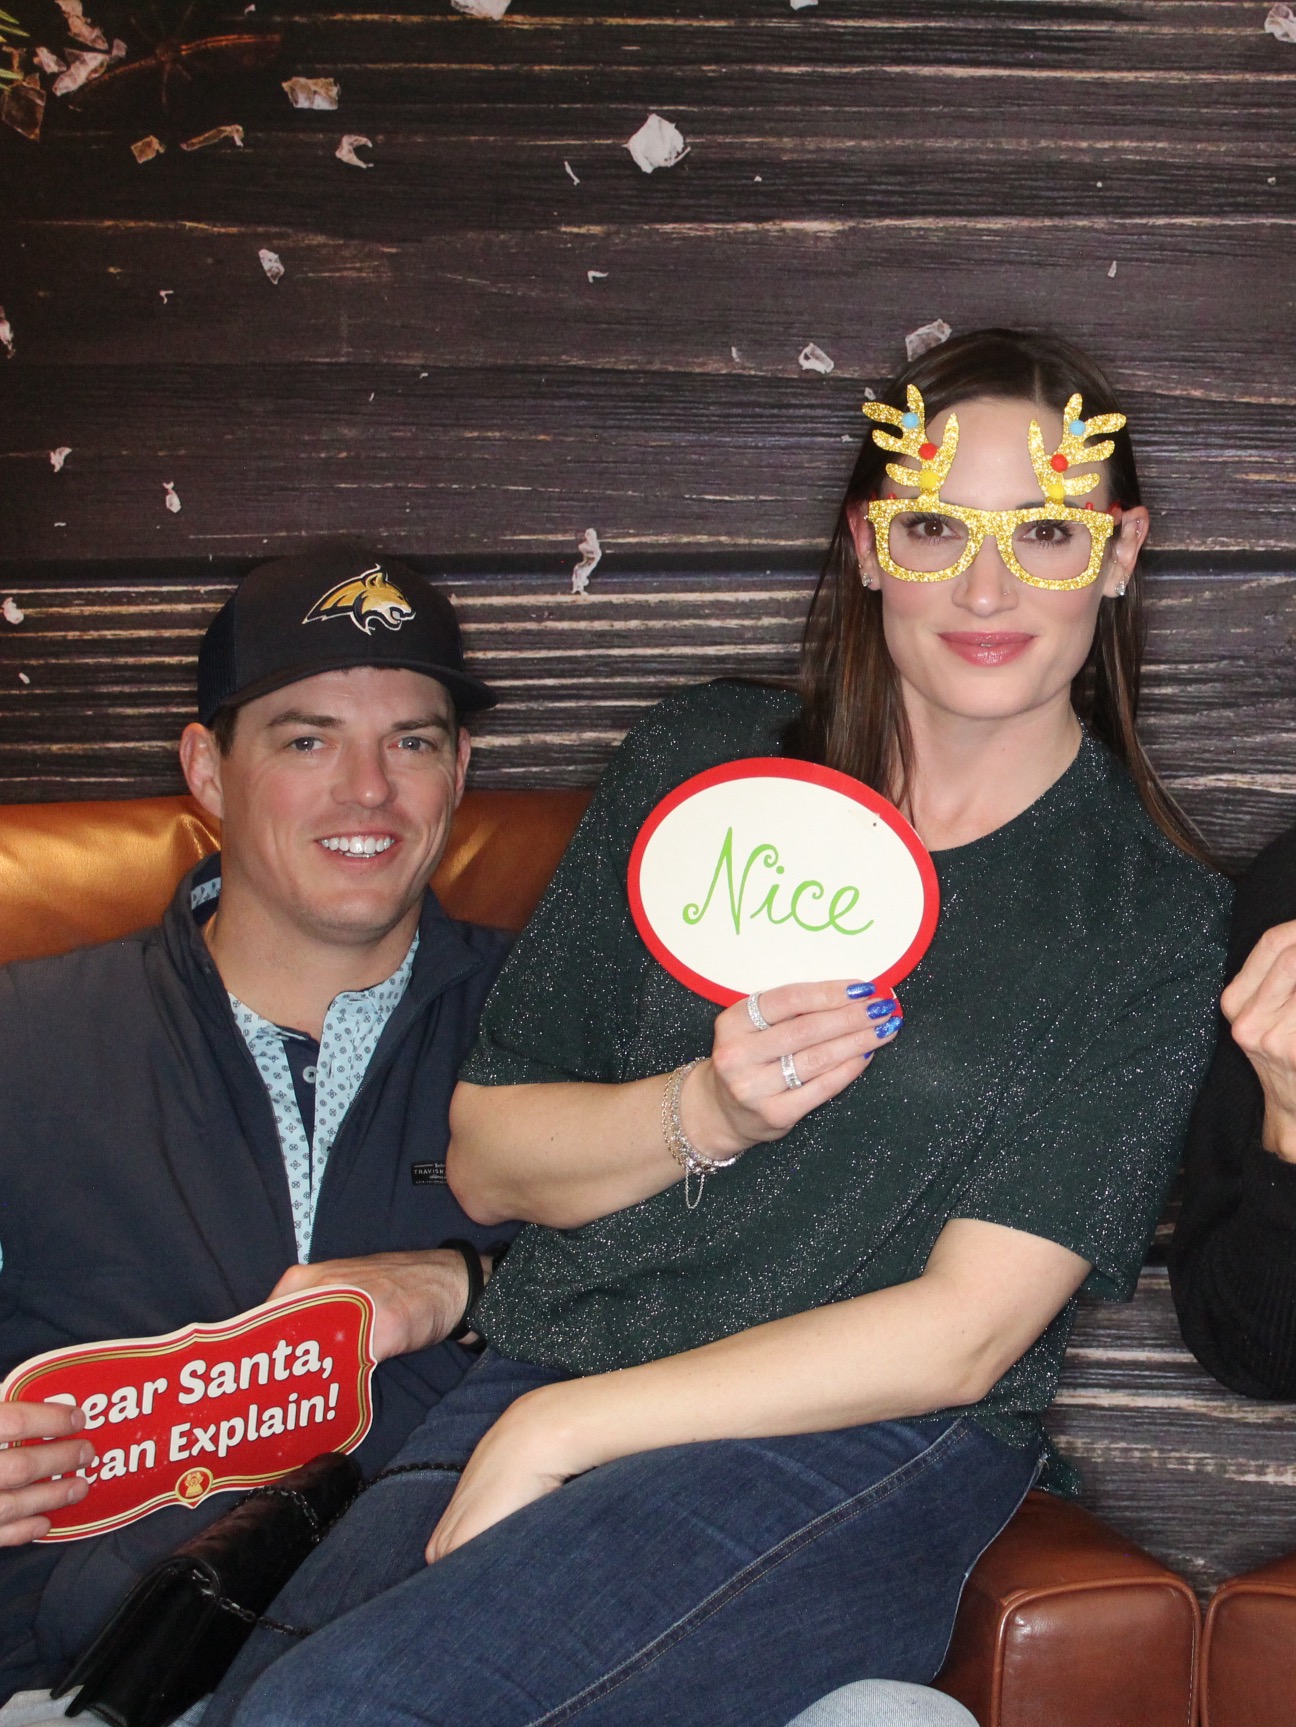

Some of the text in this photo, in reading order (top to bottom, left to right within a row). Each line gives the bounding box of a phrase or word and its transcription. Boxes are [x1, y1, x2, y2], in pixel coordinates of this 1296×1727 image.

[682, 826, 875, 936] Nice
[178, 1339, 334, 1405] Santa,
[168, 1382, 340, 1463] Explain!
